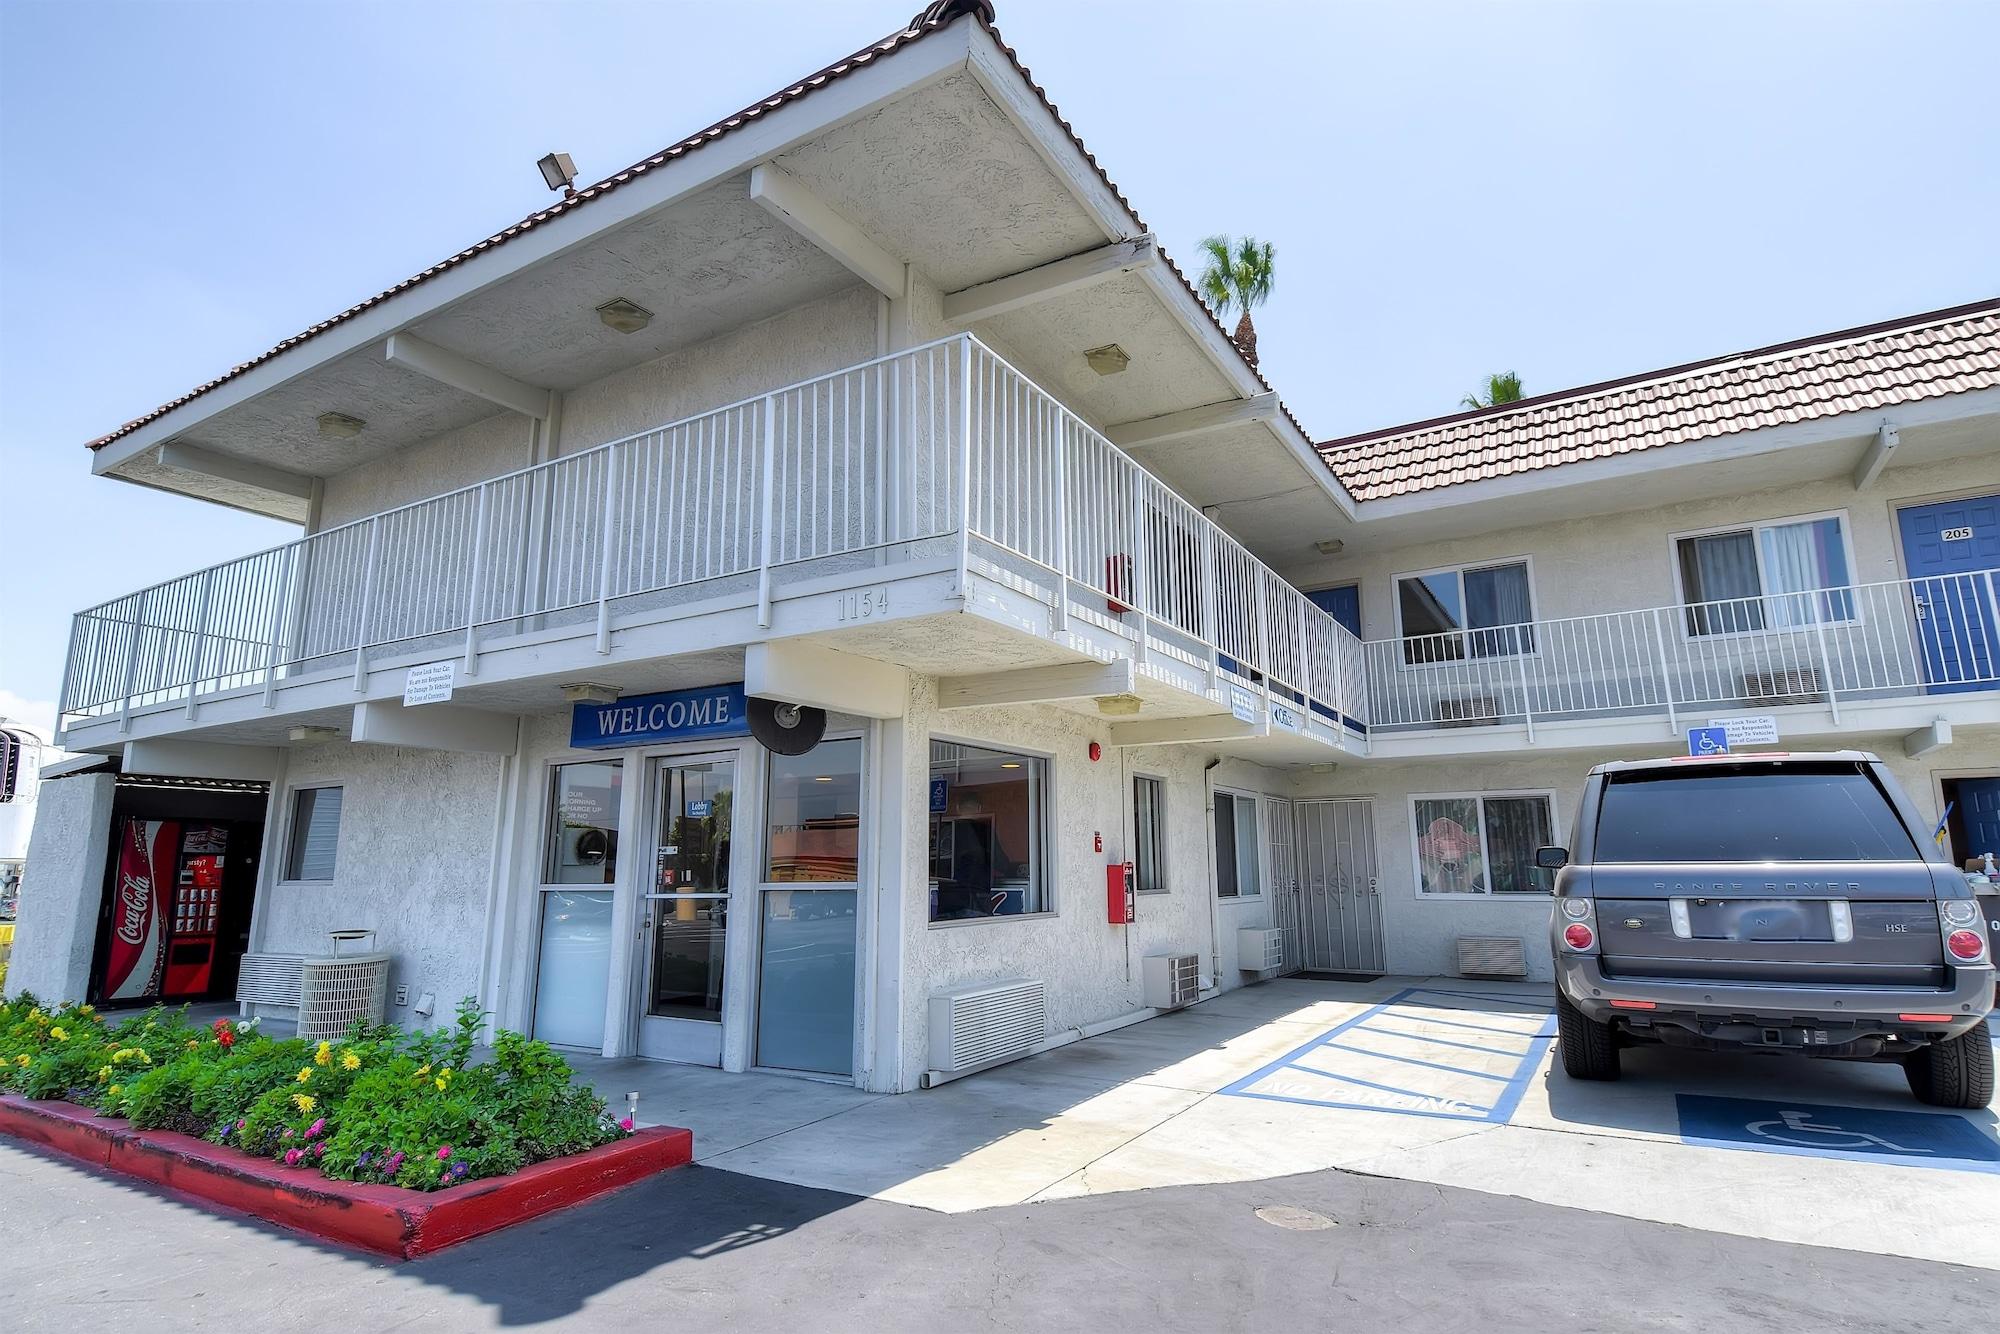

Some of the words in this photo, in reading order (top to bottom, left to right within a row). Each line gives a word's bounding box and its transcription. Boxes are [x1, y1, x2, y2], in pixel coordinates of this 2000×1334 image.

[1945, 528, 1969, 539] 205
[839, 587, 888, 621] 1154
[598, 696, 730, 736] WELCOME
[569, 798, 596, 806] ORNING
[692, 802, 708, 812] Lobby
[1654, 882, 1744, 891] RANGE
[1764, 882, 1861, 892] ROVER
[117, 872, 150, 944] Coca-Cola
[1886, 923, 1908, 933] HSE
[1261, 1081, 1312, 1095] NO
[1321, 1087, 1472, 1112] PARKING
